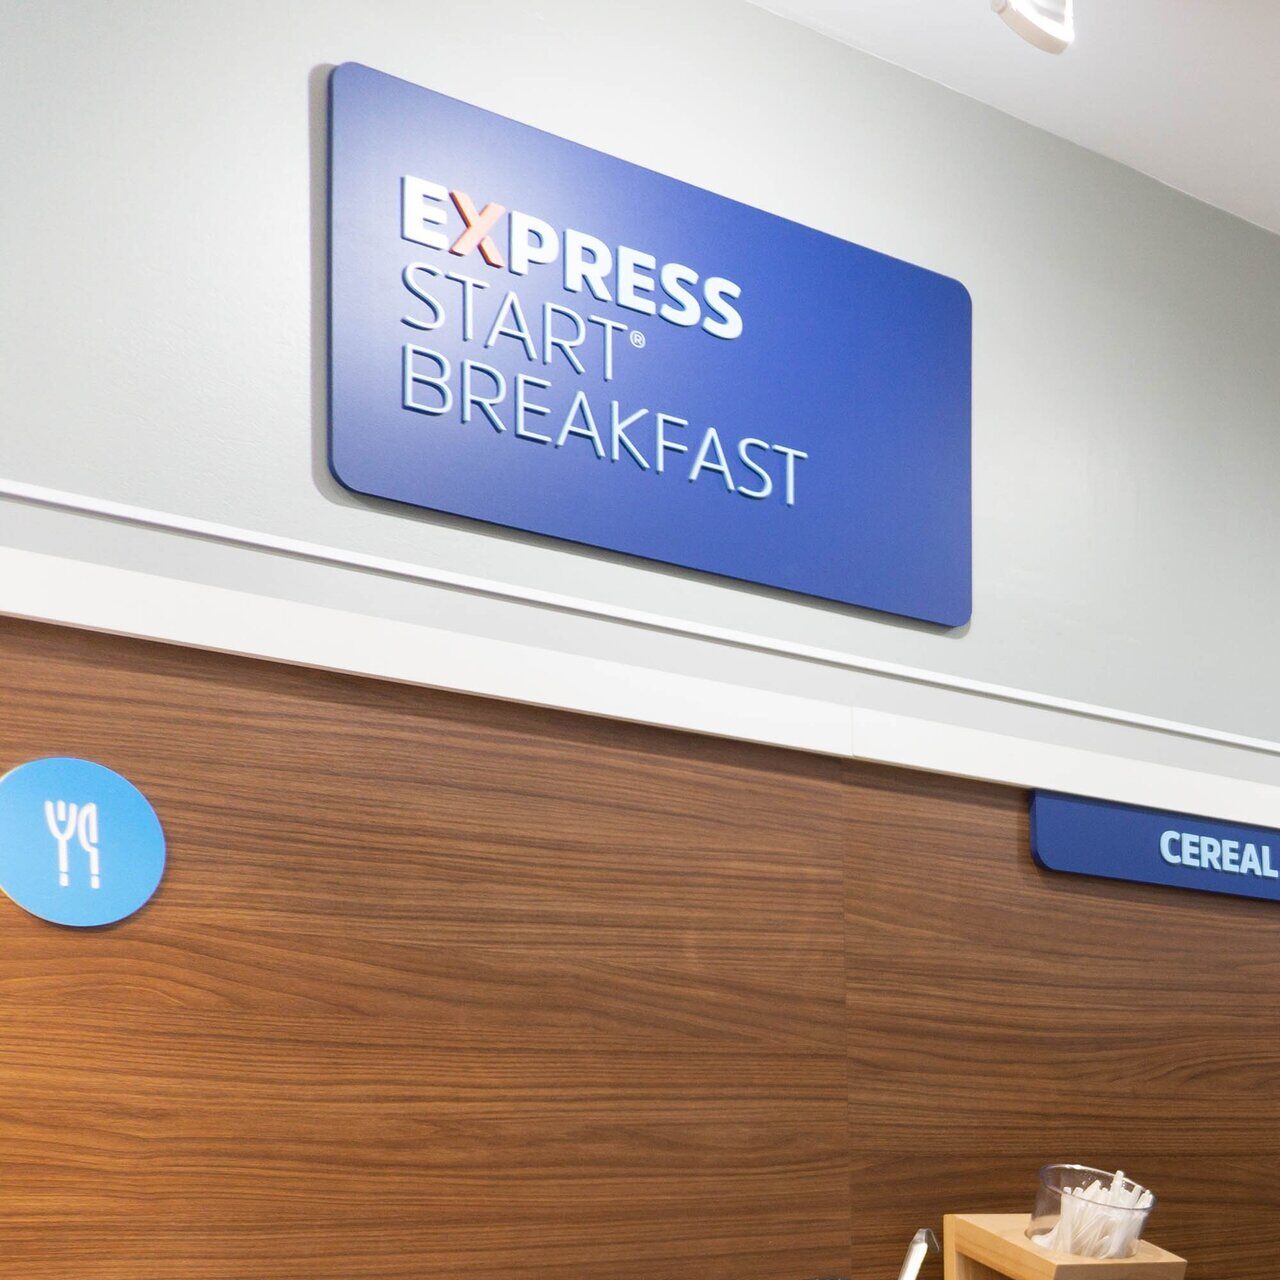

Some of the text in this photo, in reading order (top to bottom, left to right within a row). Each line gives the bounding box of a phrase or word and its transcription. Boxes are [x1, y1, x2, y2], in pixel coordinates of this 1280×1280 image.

[400, 174, 743, 342] EXPRESS
[400, 342, 809, 506] BREAKFAST
[1159, 830, 1280, 878] CEREAL
